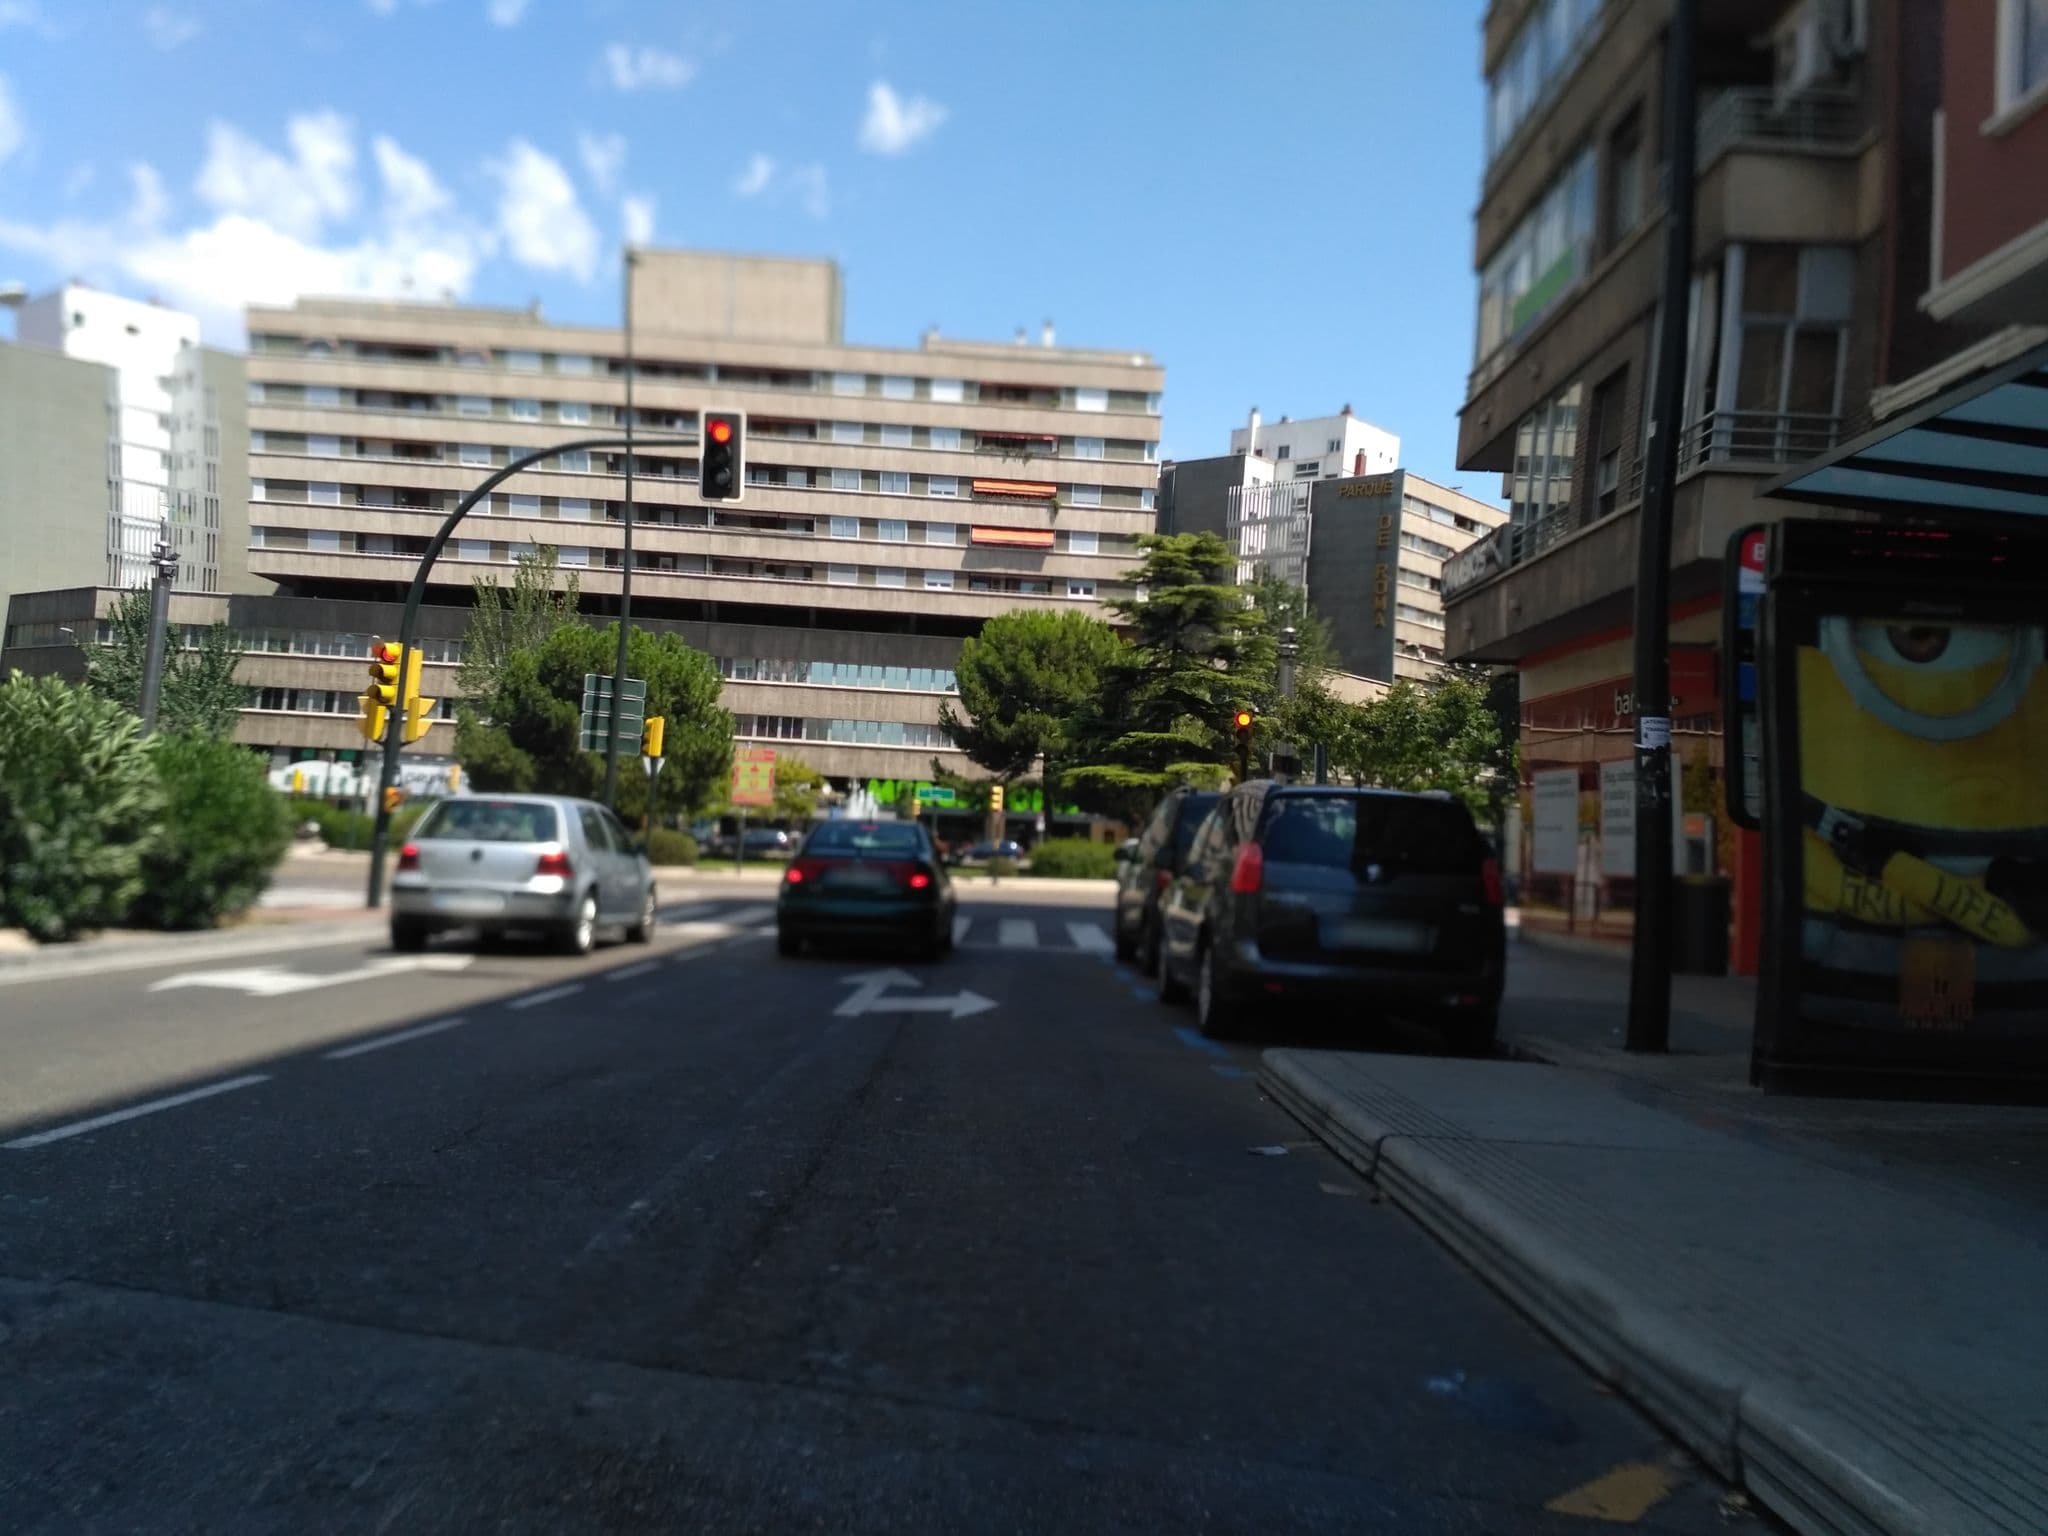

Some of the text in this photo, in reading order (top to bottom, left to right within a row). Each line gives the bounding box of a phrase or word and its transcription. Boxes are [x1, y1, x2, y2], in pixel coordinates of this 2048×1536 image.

[1339, 479, 1394, 497] PARQUE
[1374, 514, 1393, 628] DE ROMA
[1933, 873, 2006, 938] LIFE
